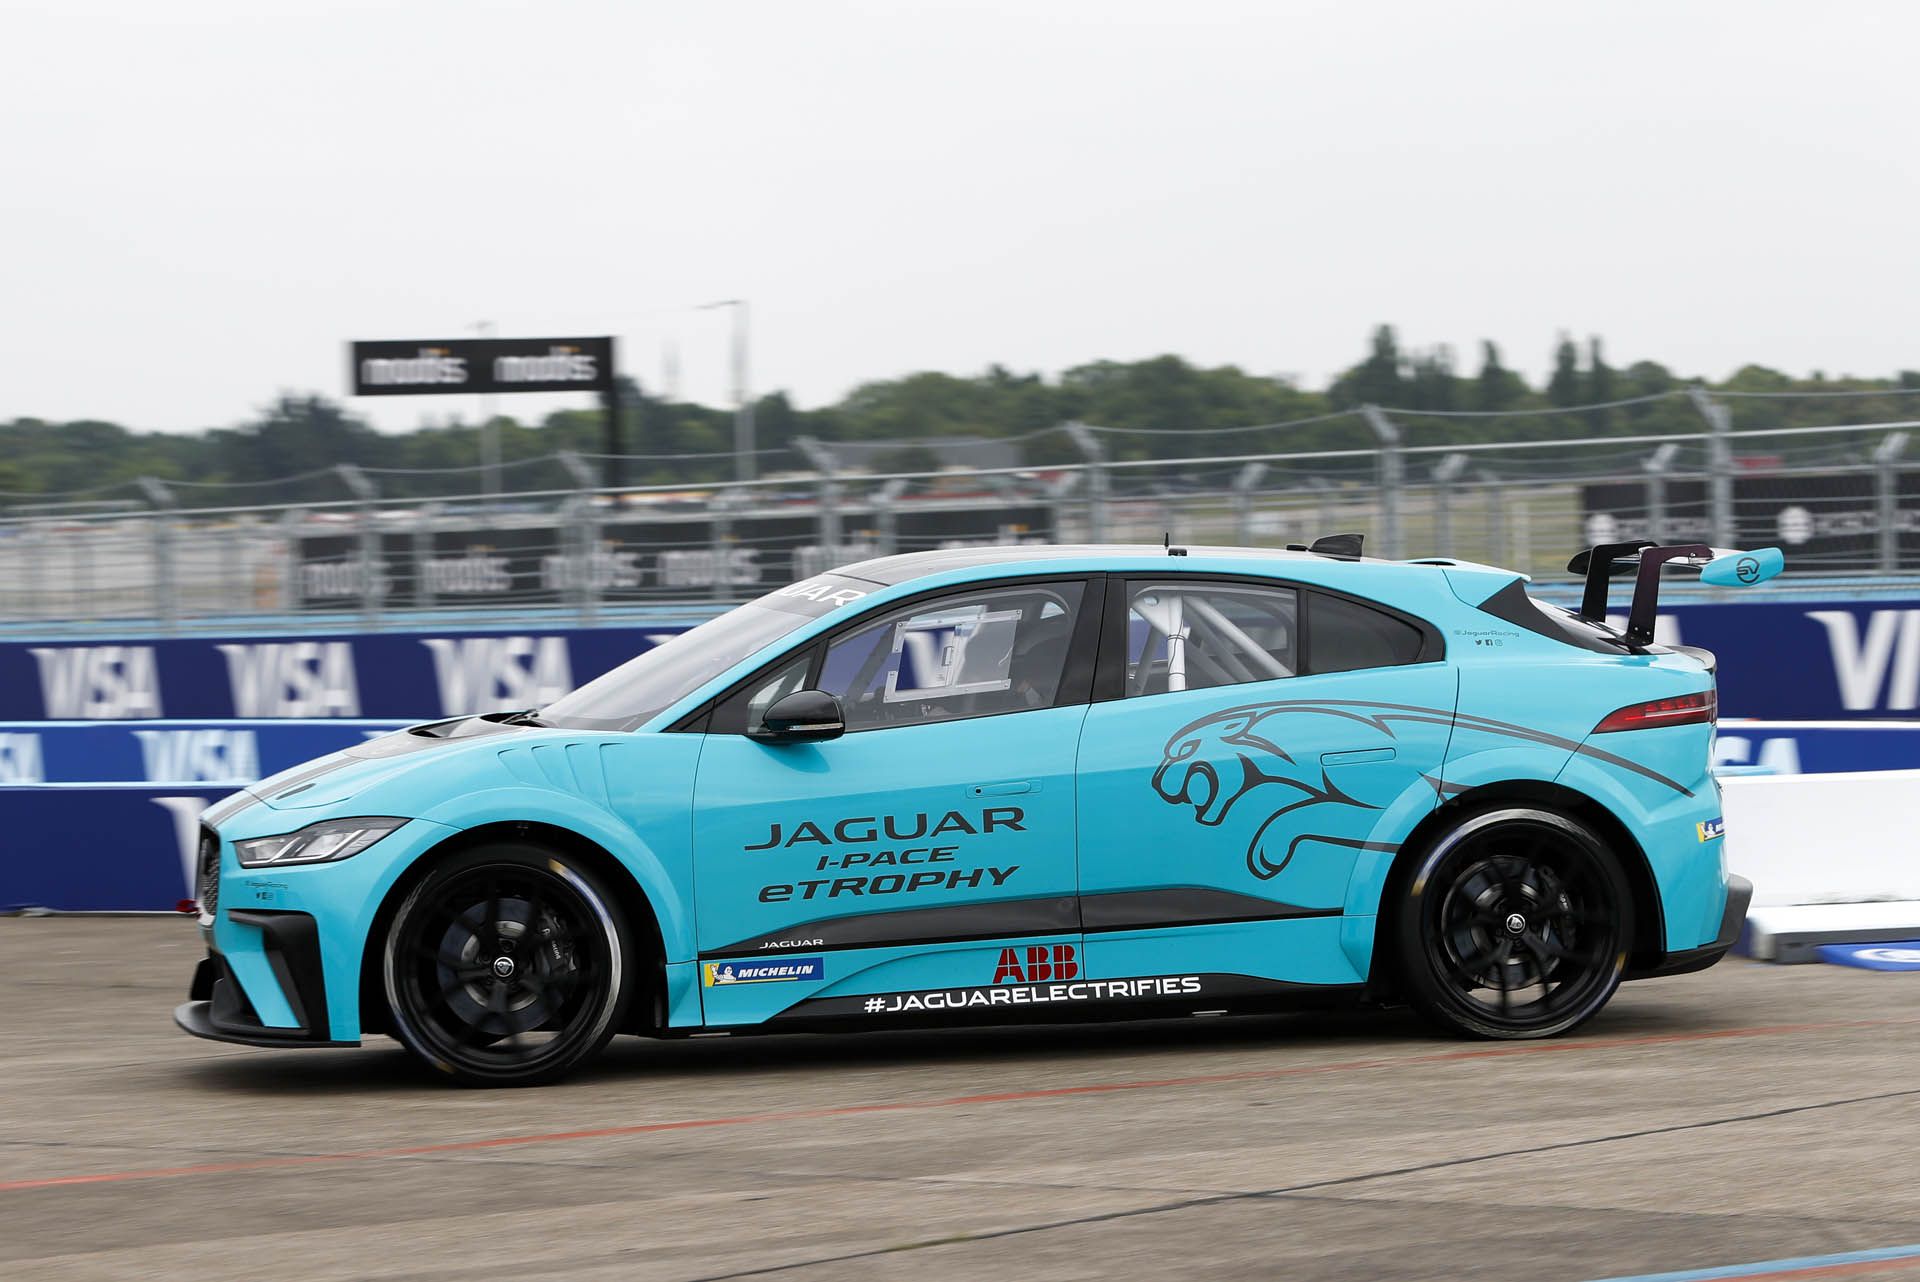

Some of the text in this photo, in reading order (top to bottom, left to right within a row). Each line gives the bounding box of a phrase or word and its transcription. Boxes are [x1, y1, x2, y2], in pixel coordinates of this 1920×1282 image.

[25, 646, 164, 719] VISA
[213, 641, 362, 718] VISA
[417, 636, 575, 718] VISA
[130, 729, 262, 782] VISA
[744, 806, 1028, 851] JAGUAR
[816, 845, 960, 871] I-PACE
[758, 865, 1021, 903] eTROPHY
[758, 938, 824, 950] JAGUAR
[737, 964, 815, 979] MICHELIN
[992, 945, 1079, 984] ABB
[863, 976, 1203, 1014] #JAGUARELECTRIFIES
